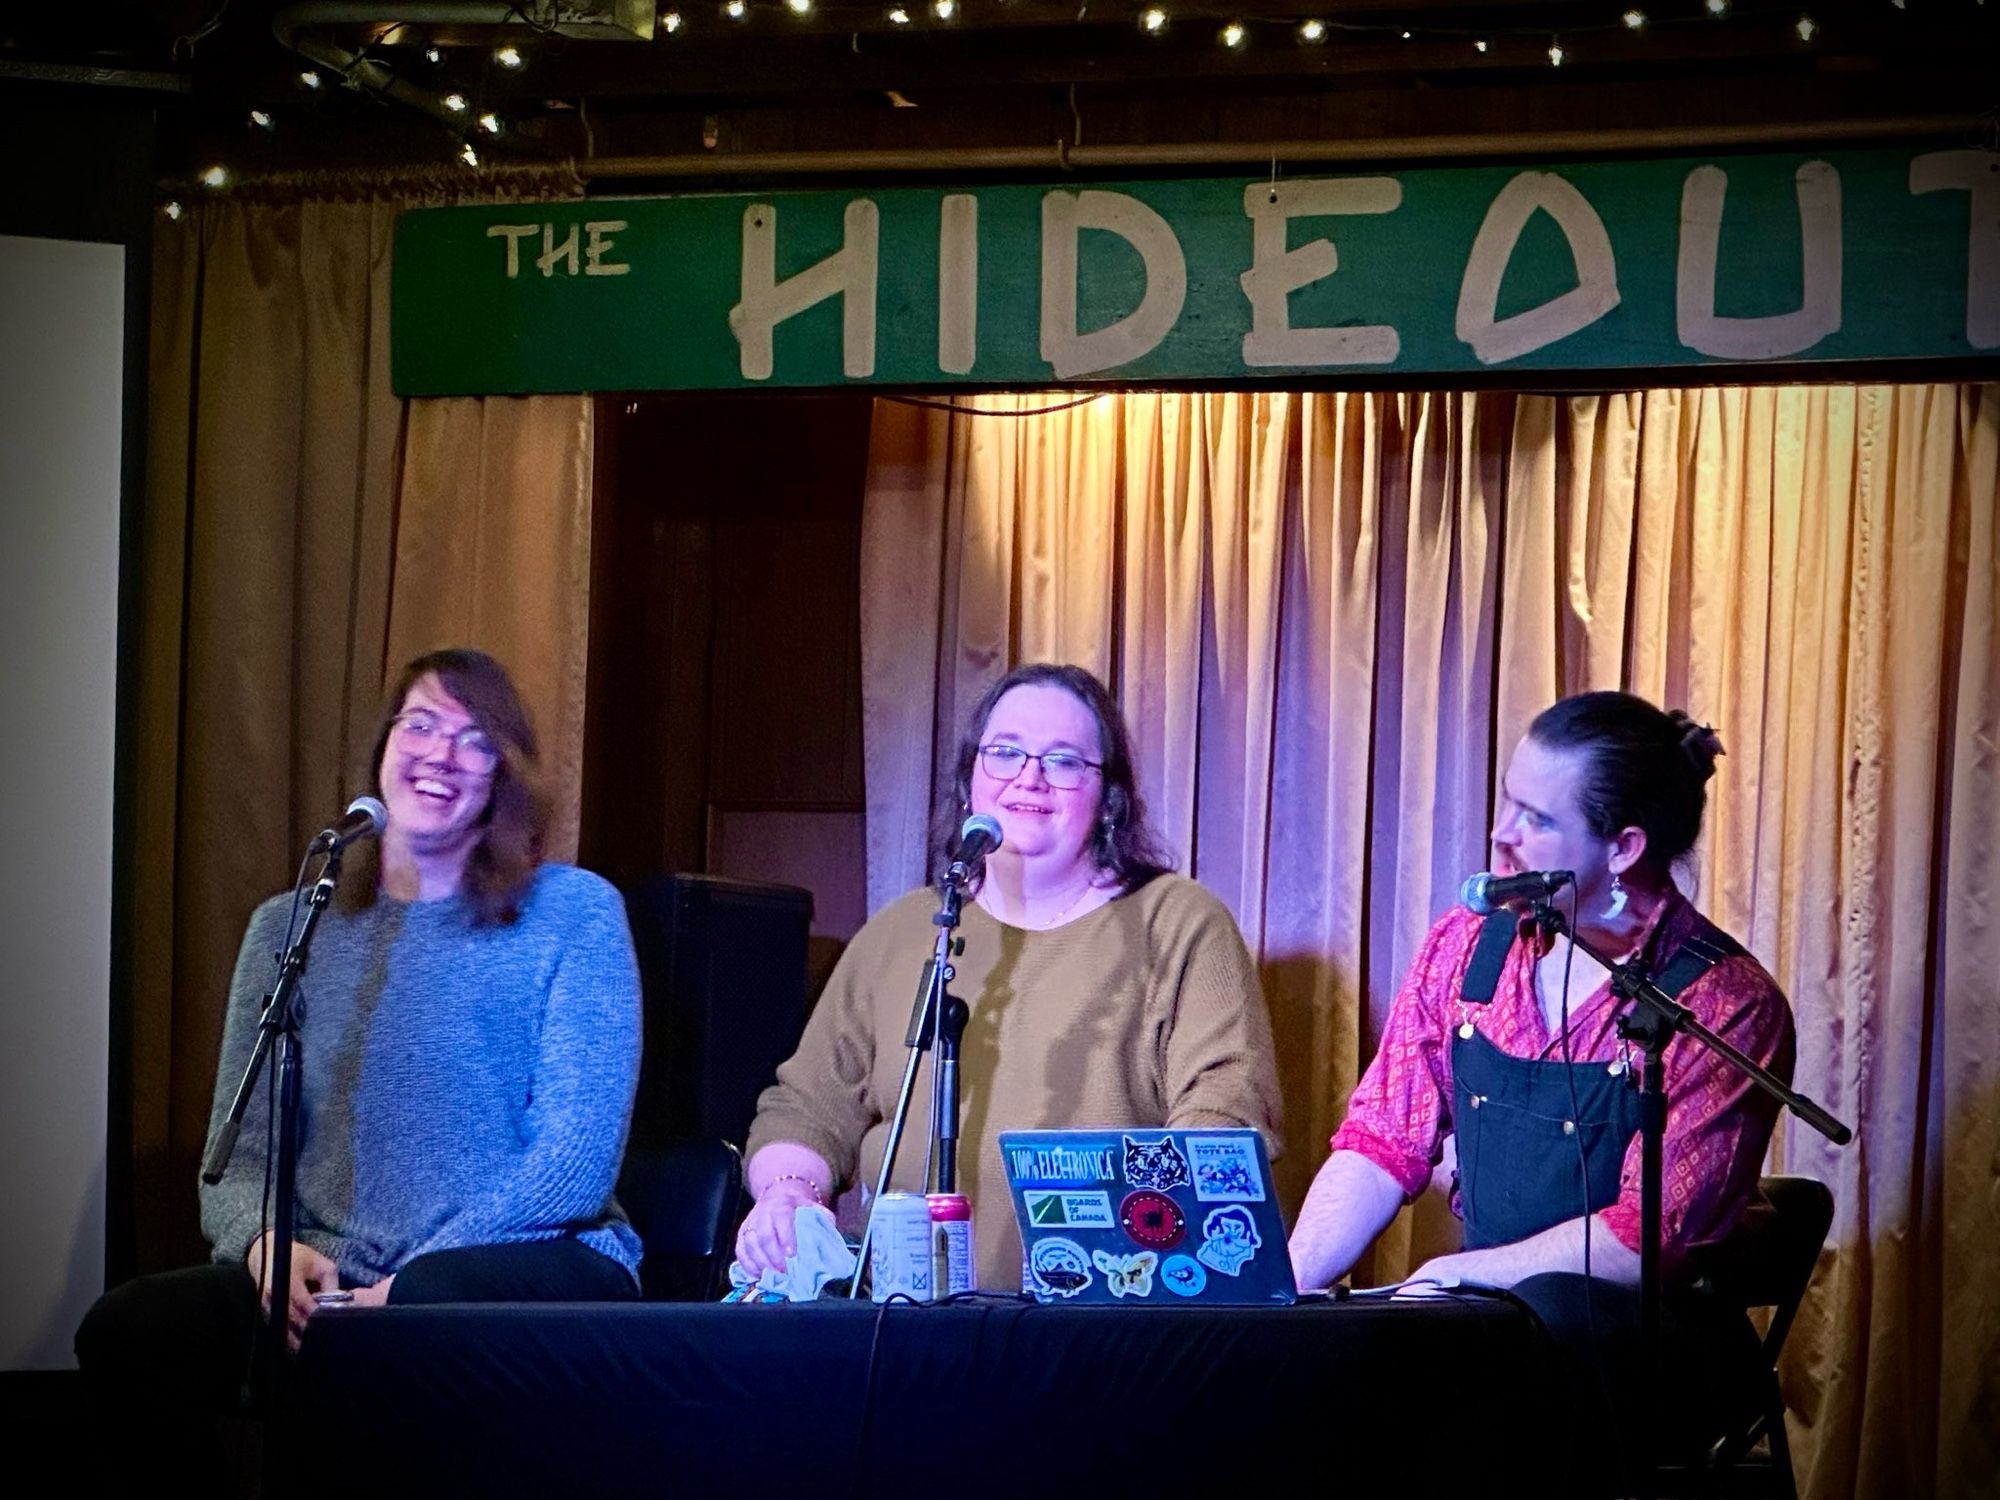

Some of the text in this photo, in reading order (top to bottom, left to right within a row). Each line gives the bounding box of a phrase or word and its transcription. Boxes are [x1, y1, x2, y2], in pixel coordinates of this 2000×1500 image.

[487, 151, 2000, 380] THE HIDEOUT
[1037, 1148, 1115, 1181] ELECTRONICA
